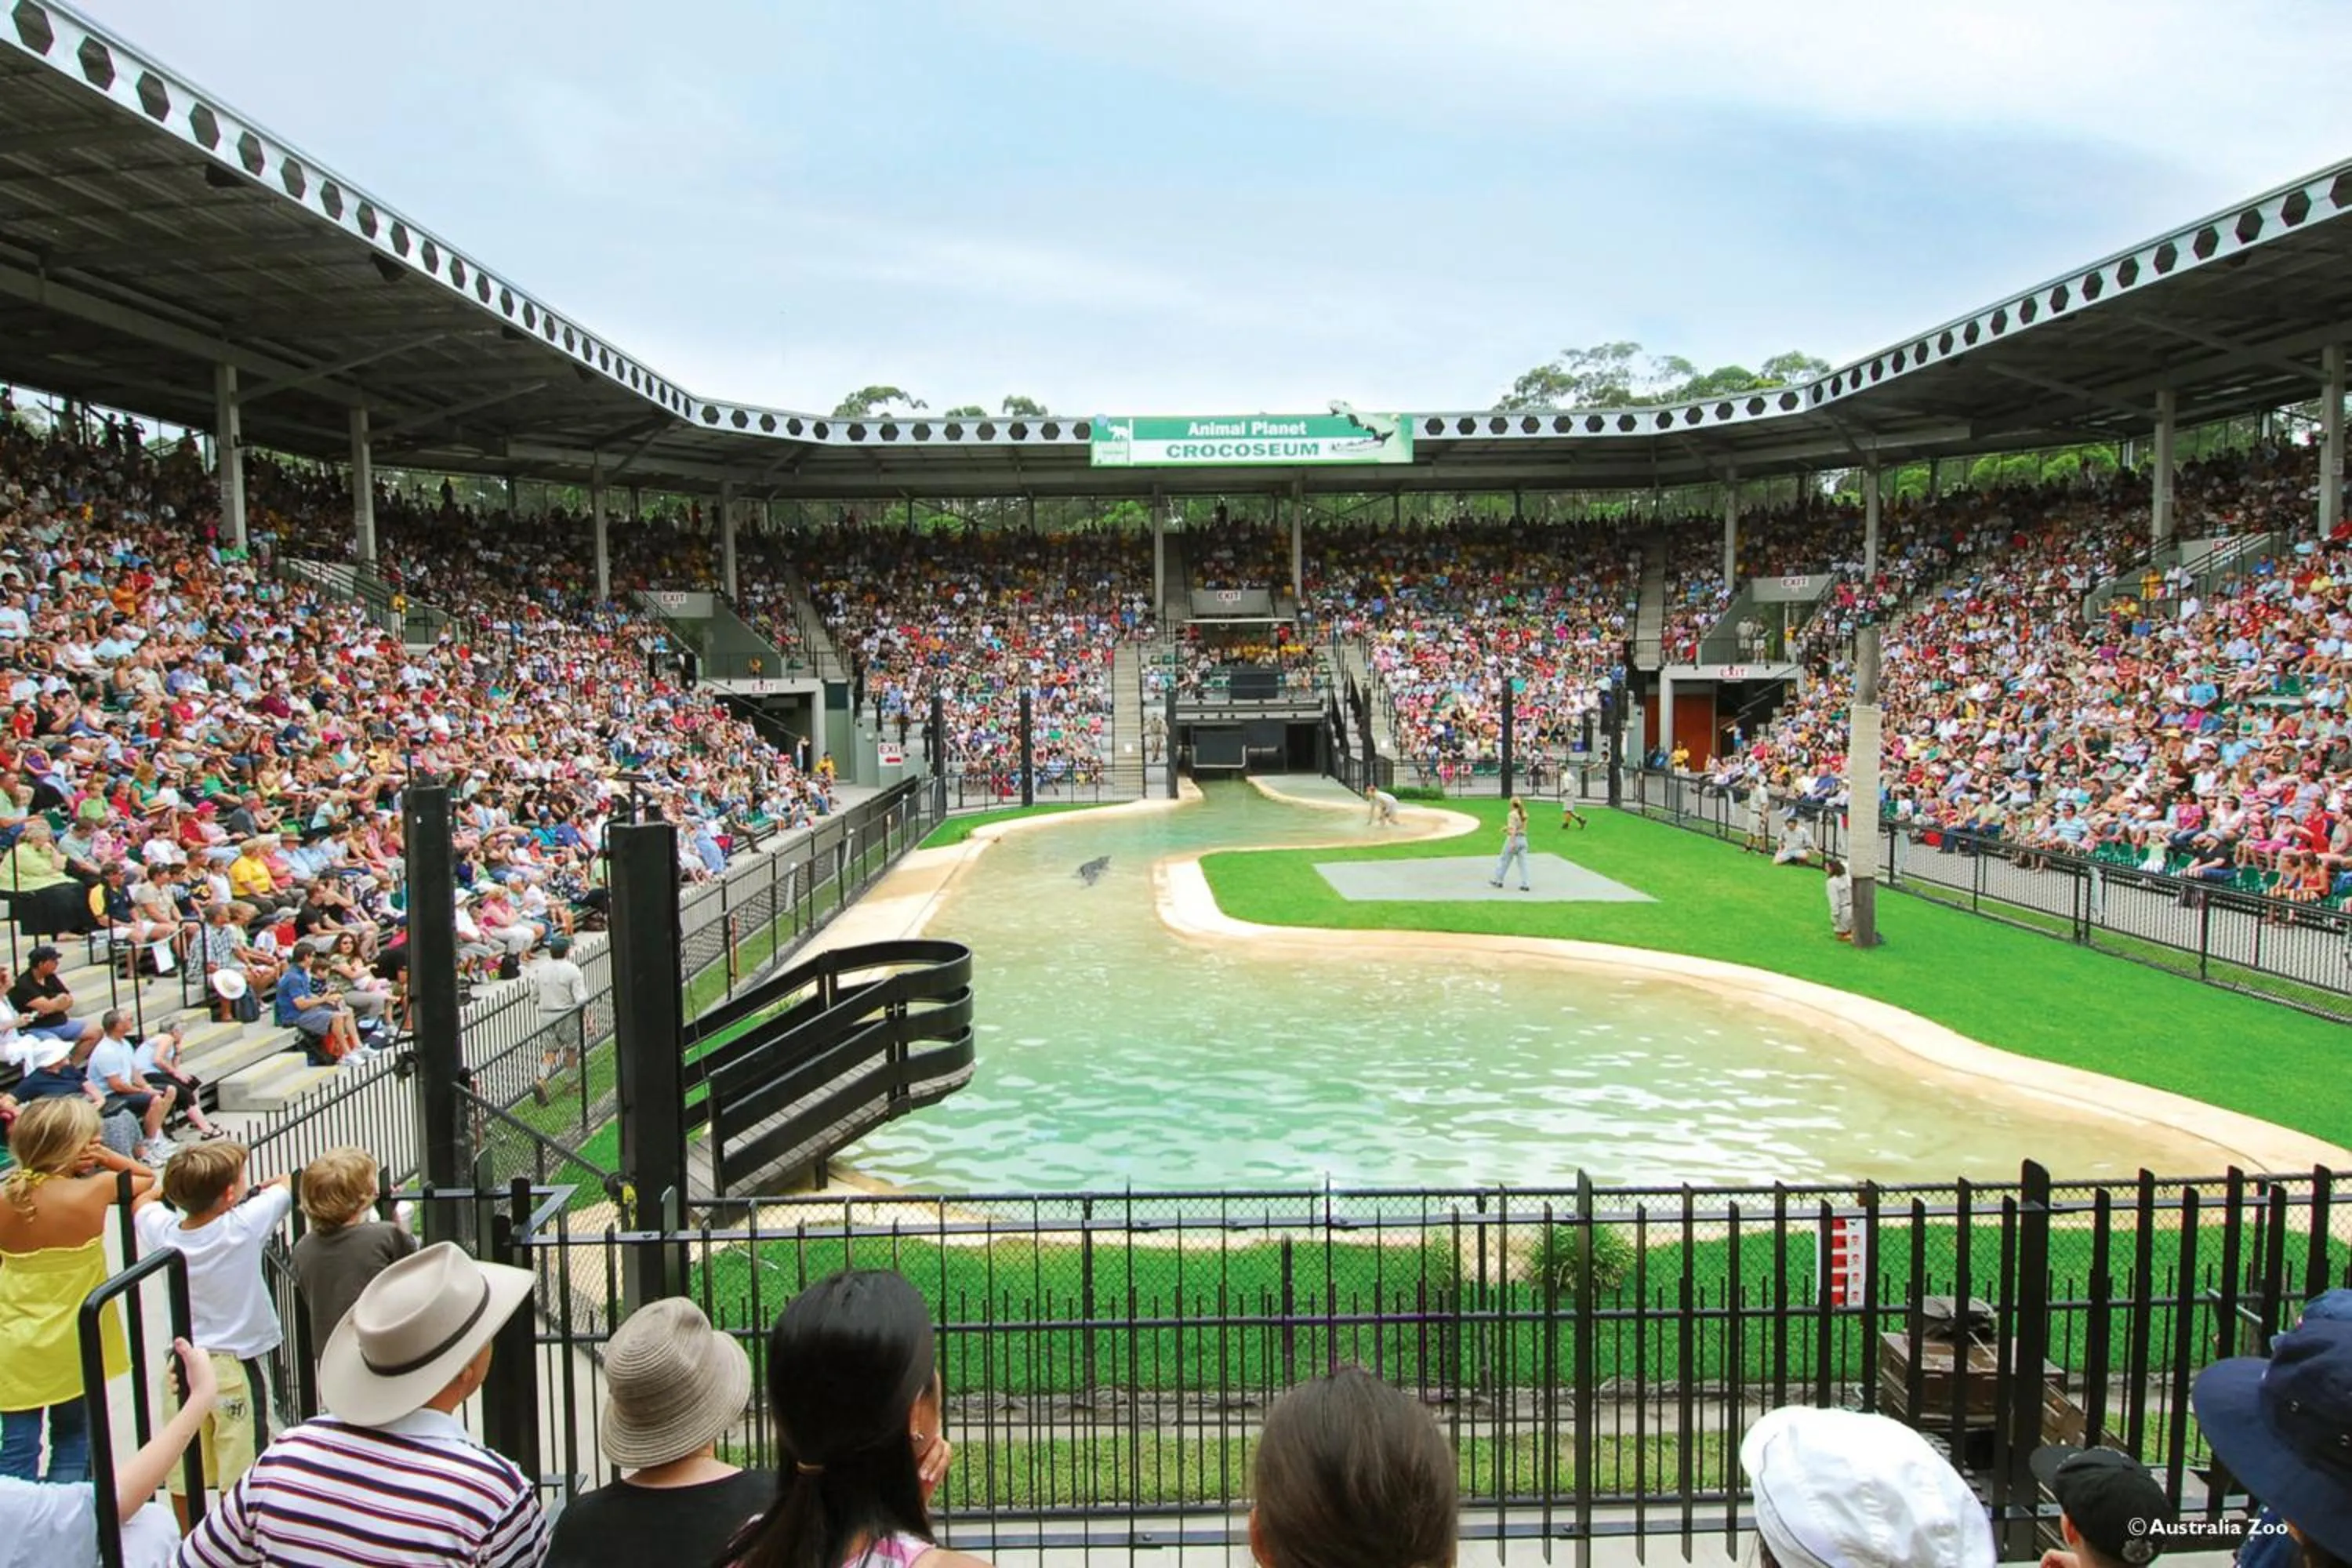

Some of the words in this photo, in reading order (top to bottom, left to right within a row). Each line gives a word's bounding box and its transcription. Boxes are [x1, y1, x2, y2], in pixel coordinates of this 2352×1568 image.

[1188, 422, 1245, 436] Animal
[1251, 420, 1307, 435] Planet
[1166, 442, 1319, 458] CROCOSEUM
[1783, 578, 1806, 586] EXIT
[662, 593, 684, 602] EXIT
